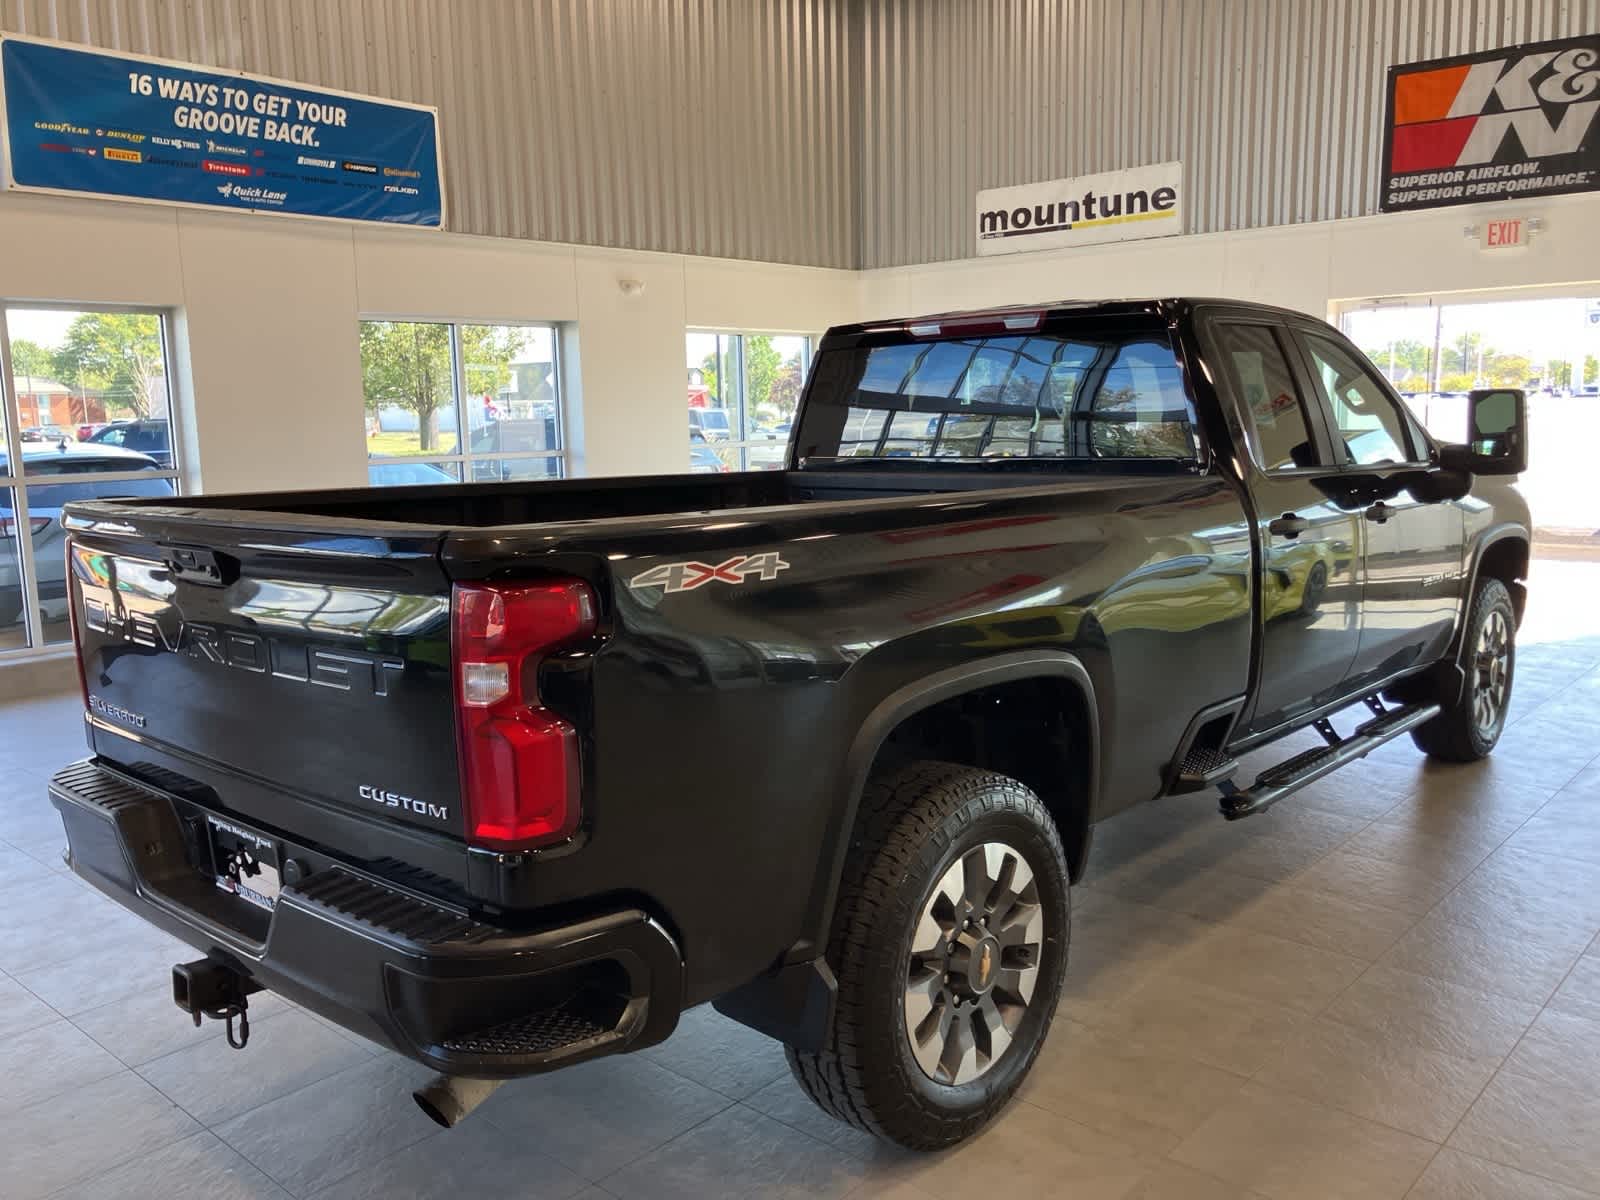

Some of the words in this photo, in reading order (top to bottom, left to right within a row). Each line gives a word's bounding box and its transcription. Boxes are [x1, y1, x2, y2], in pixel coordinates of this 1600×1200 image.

[129, 73, 153, 95] 16
[157, 78, 219, 106] WAYS
[223, 87, 249, 111] TO
[253, 93, 292, 118] GET
[296, 100, 347, 127] YOUR
[34, 121, 89, 135] GOODYEAR
[106, 131, 146, 143] DUNLOP
[174, 106, 260, 138] GROOVE
[264, 120, 320, 147] BACK.
[151, 136, 171, 147] KELLY
[207, 163, 247, 175] Firestone
[1389, 170, 1466, 190] SUPERIOR
[1467, 162, 1541, 181] AIRFLOW.
[232, 185, 262, 198] Quick
[262, 188, 287, 201] Lane
[1388, 186, 1464, 205] SUPERIOR
[979, 186, 1177, 233] mountune
[1487, 219, 1522, 246] EXIT
[84, 596, 405, 697] CHEVROLET
[88, 694, 145, 728] SILVERADO
[359, 784, 448, 820] CUSTOM
